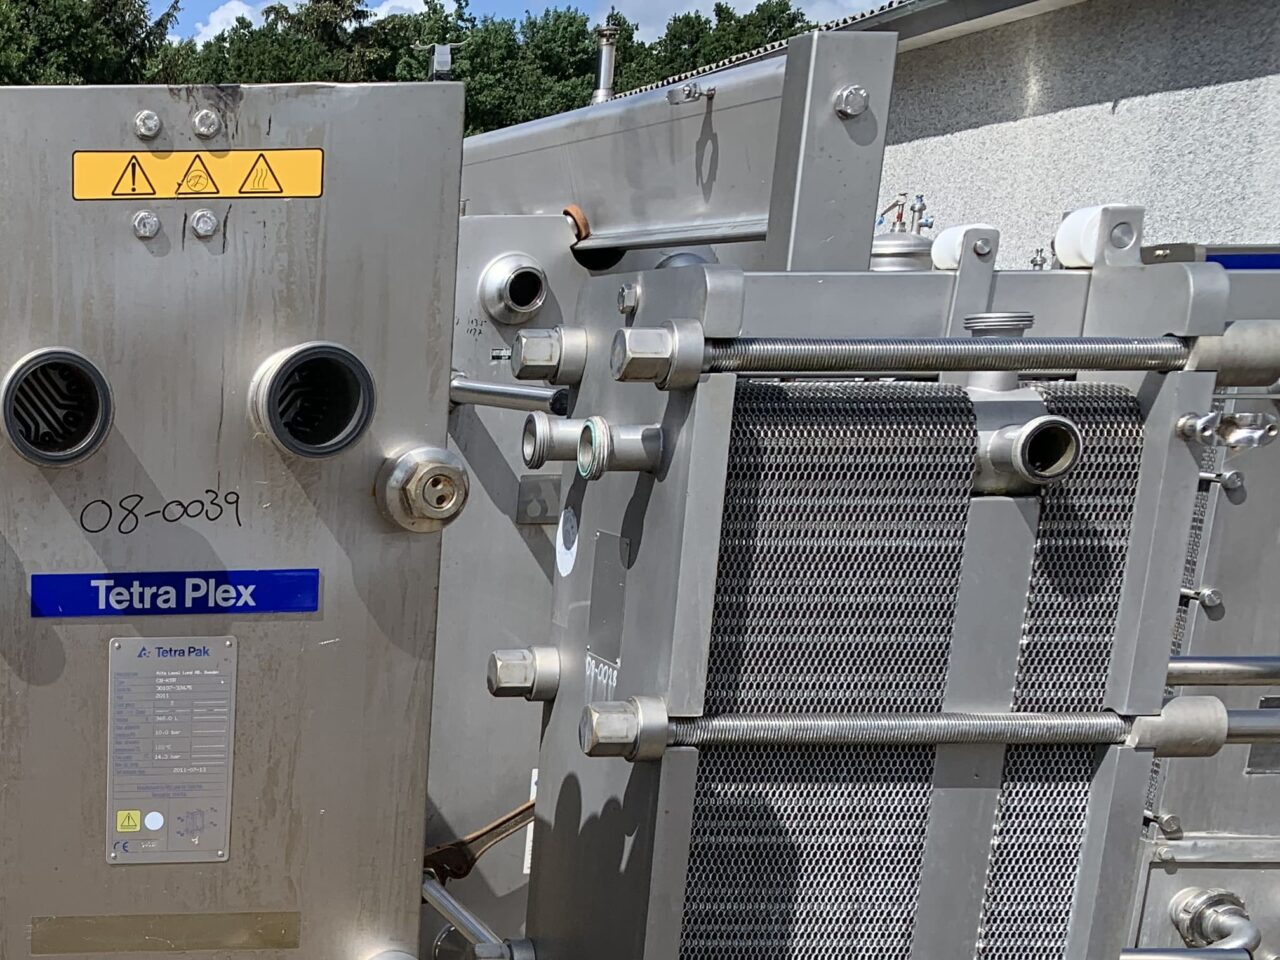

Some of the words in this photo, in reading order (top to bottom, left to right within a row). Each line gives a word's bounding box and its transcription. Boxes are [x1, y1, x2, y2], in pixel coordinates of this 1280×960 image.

[80, 489, 242, 534] 08-0039
[90, 578, 177, 610] Tetra
[184, 577, 257, 608] Plex
[155, 646, 185, 658] Tetra
[187, 646, 210, 657] Pak
